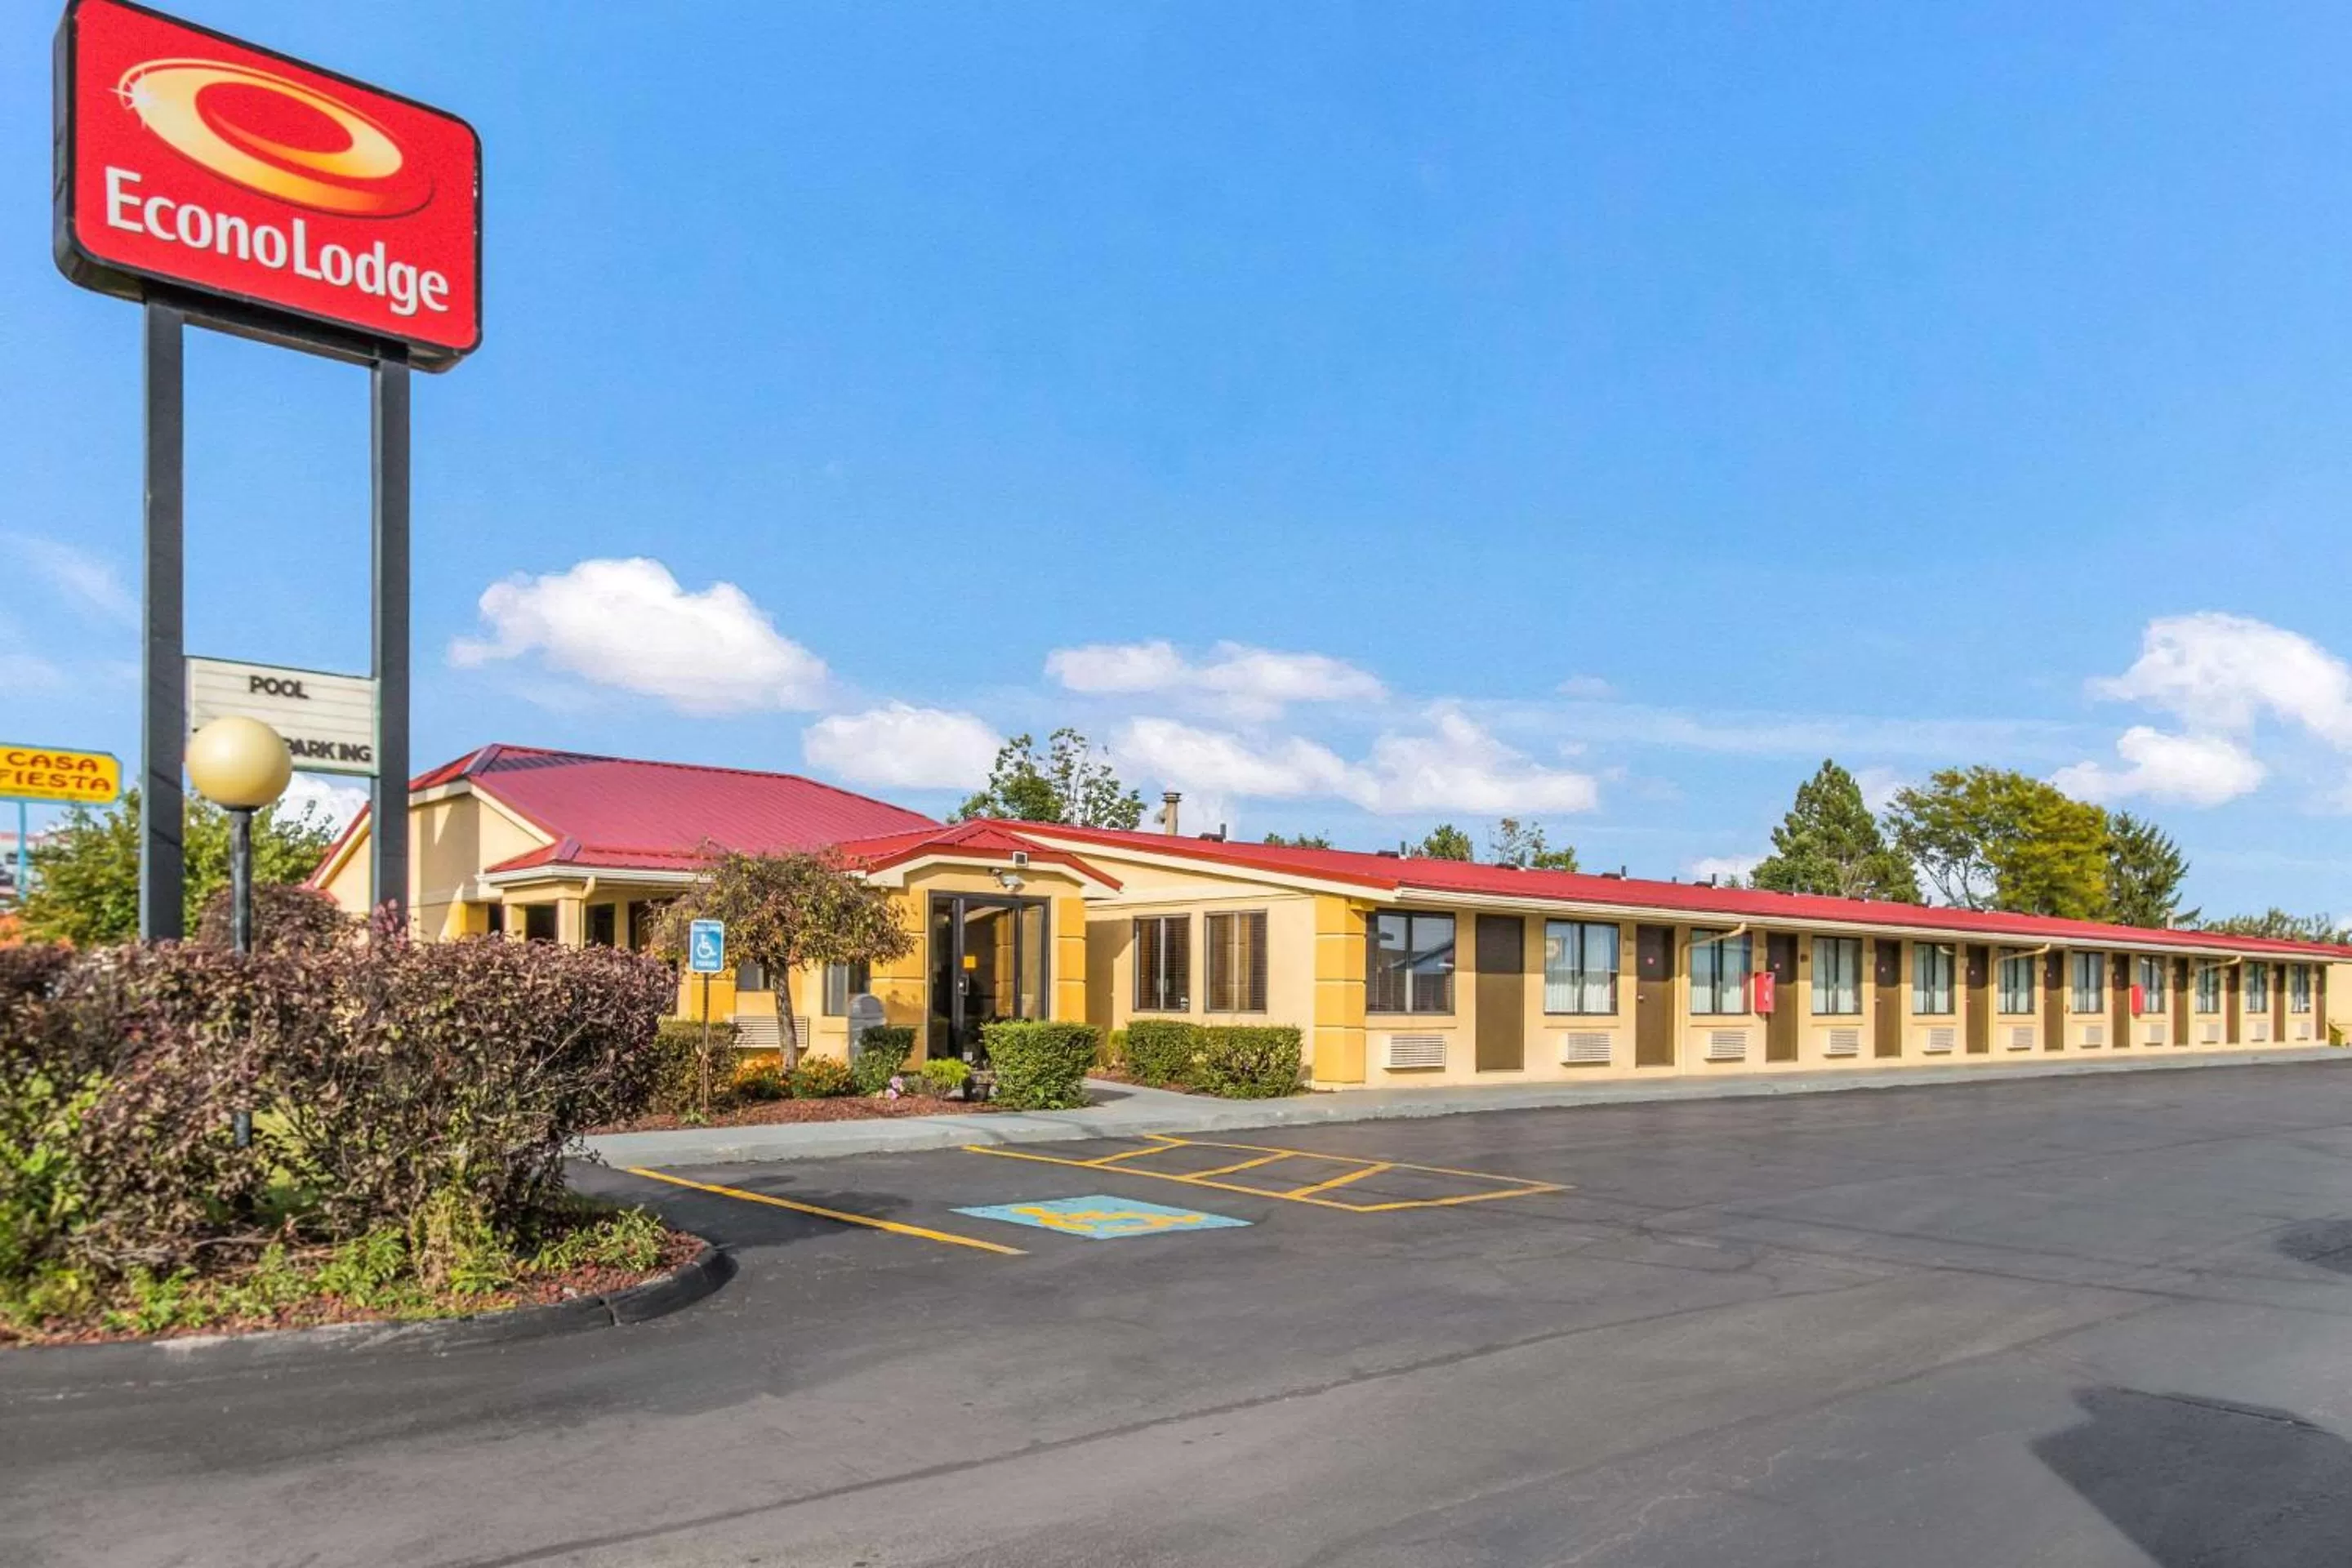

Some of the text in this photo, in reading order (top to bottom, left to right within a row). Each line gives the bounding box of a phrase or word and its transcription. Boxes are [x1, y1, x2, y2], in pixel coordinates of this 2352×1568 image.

[105, 166, 449, 317] EconoLodge
[249, 675, 310, 699] POOL
[7, 751, 98, 773] CASA
[0, 769, 111, 791] FIESTA
